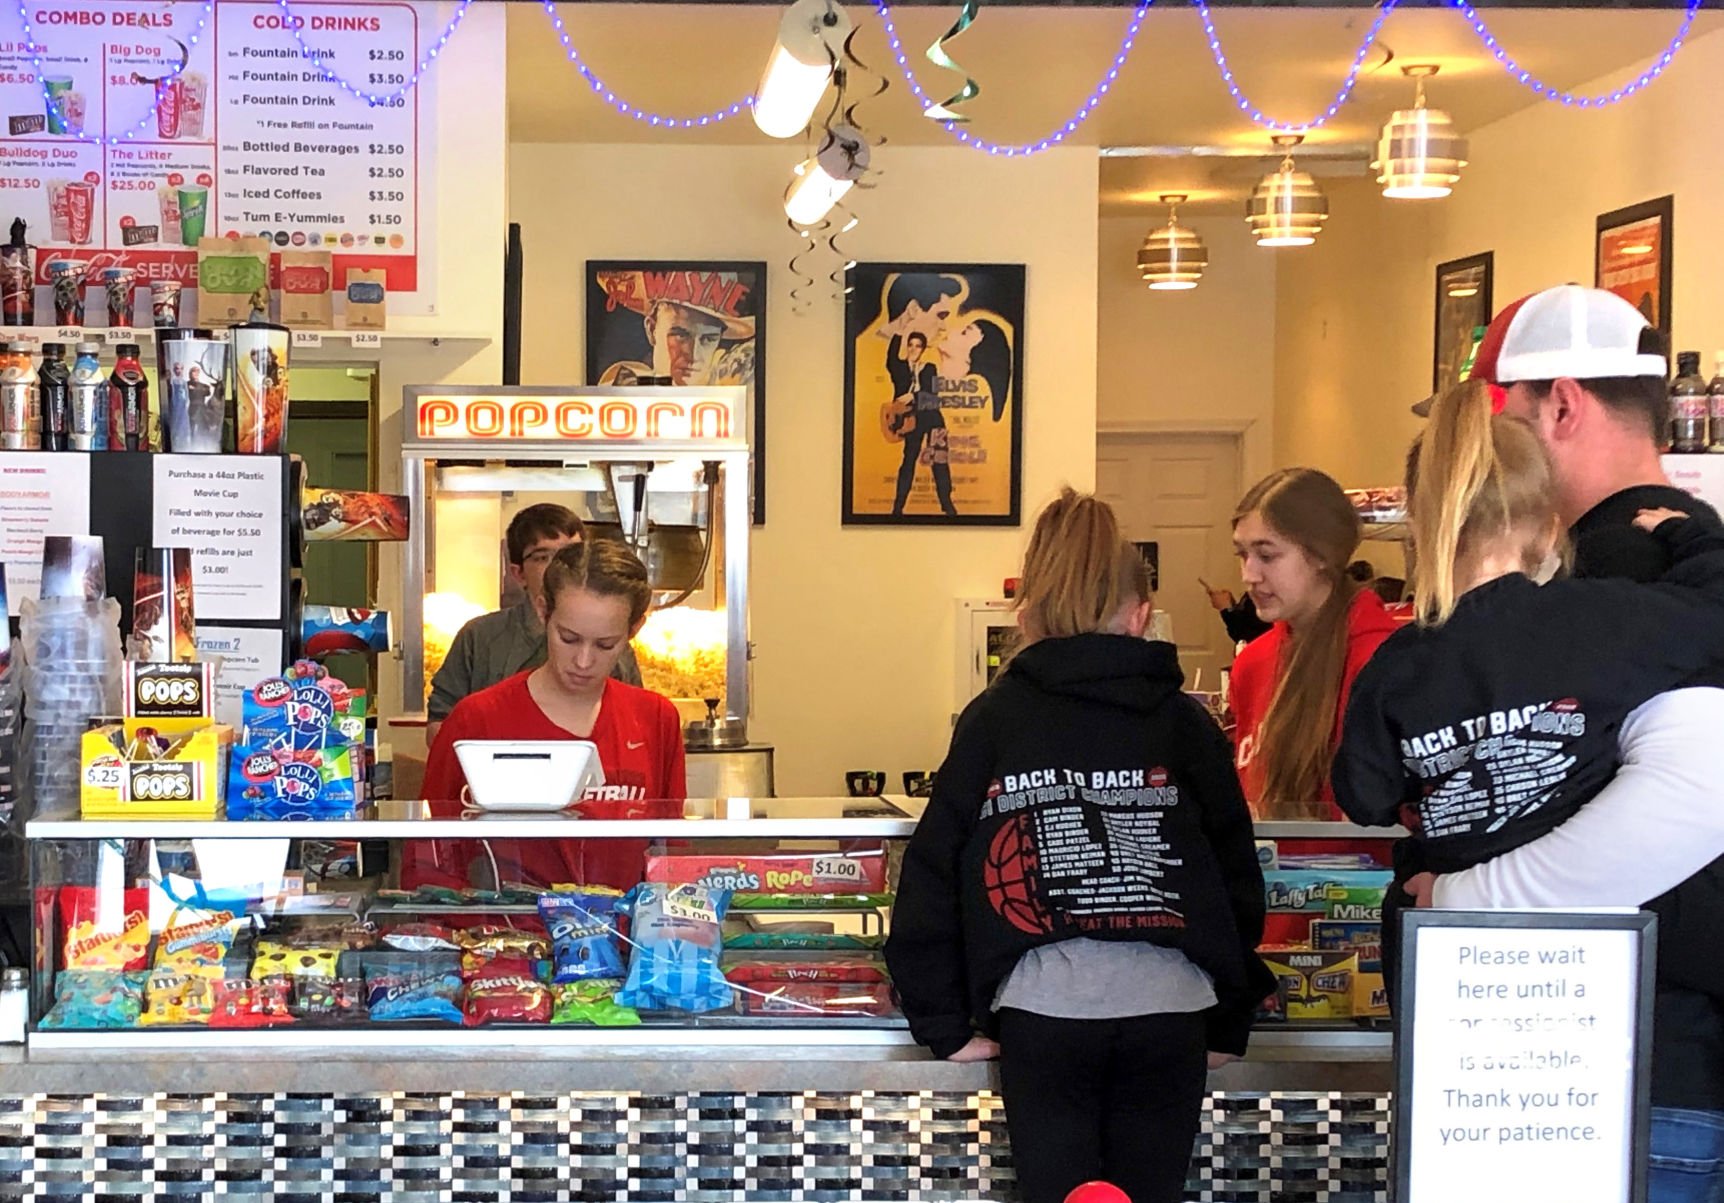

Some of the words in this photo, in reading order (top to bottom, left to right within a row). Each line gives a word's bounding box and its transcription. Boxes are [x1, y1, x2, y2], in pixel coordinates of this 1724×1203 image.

[36, 10, 105, 25] COMBO
[112, 12, 173, 27] DEALS
[253, 15, 305, 29] COLD
[311, 16, 380, 32] DRINKS
[18, 43, 48, 56] Pps
[110, 45, 131, 56] Big
[135, 45, 161, 57] Dog
[242, 47, 298, 58] Fountain
[302, 48, 335, 59] Drink
[368, 50, 404, 61] $2.50
[0, 73, 34, 85] $6.50
[110, 75, 146, 86] $8.0
[242, 71, 298, 82] Fountain
[302, 71, 336, 83] Drink
[368, 73, 404, 84] $3.50
[242, 95, 298, 105] Fountain
[302, 95, 335, 106] Drink
[332, 122, 373, 130] Fountain
[0, 148, 48, 159] Bulldog
[52, 148, 78, 159] Duo
[243, 141, 289, 152] Bottled
[294, 142, 359, 155] Beverages
[368, 144, 404, 155] $2.50
[111, 150, 134, 160] The
[138, 150, 172, 160] Litter
[243, 165, 298, 176] Flavored
[303, 166, 325, 176] Tea
[368, 167, 404, 178] $2.50
[0, 178, 40, 189] $12.50
[111, 180, 156, 191] $25.00
[243, 189, 269, 199] Iced
[274, 188, 322, 200] Coffees
[368, 191, 404, 202] $3.50
[243, 212, 270, 222] Tum
[275, 212, 345, 224] E-Yummies
[368, 214, 401, 225] $1.50
[643, 271, 750, 318] WAYNE
[297, 334, 318, 342] $3.50
[932, 376, 979, 392] ELVIS
[168, 470, 206, 479] Purchase
[216, 471, 235, 479] 44oz
[237, 472, 264, 480] Plastic
[194, 489, 220, 497] Movie
[222, 490, 239, 498] Cup
[194, 509, 212, 517] with
[236, 510, 263, 518] choice
[171, 527, 180, 535] of
[182, 527, 220, 537] beverage
[223, 528, 235, 536] for
[237, 529, 261, 537] $5.50
[196, 548, 219, 556] refills
[237, 549, 253, 558] just
[197, 637, 231, 650] Frozen
[233, 637, 241, 650] 2
[159, 664, 192, 673] Tootsie
[139, 679, 198, 703] POPS
[263, 681, 284, 692] JOLLY
[294, 690, 329, 709] LOLLI
[285, 701, 330, 729] POPS
[250, 755, 272, 766] JOLLY
[87, 769, 119, 782] $.25
[281, 766, 317, 783] LOLLI
[1005, 768, 1056, 792] BACK
[1092, 770, 1144, 789] BACK
[134, 775, 190, 799] POPS
[274, 776, 318, 800] POPS
[997, 785, 1076, 812] DISTRICT
[1081, 786, 1179, 806] CHAMPIONS
[815, 861, 856, 876] $1.00
[1051, 862, 1072, 870] JAMES
[1269, 889, 1307, 908] Laffy
[1334, 904, 1383, 920] Mike
[1109, 915, 1133, 928] THE
[1289, 955, 1323, 967] MINI
[1459, 946, 1529, 965] Please
[1537, 946, 1586, 964] wait
[387, 973, 446, 1001] CHEWY
[1457, 979, 1508, 998] here
[1516, 979, 1566, 998] until
[1574, 983, 1586, 998] a
[1443, 1088, 1512, 1108] Thank
[1518, 1092, 1559, 1111] you
[1567, 1087, 1599, 1107] for
[1440, 1127, 1491, 1145] your
[1498, 1122, 1601, 1144] patience.
